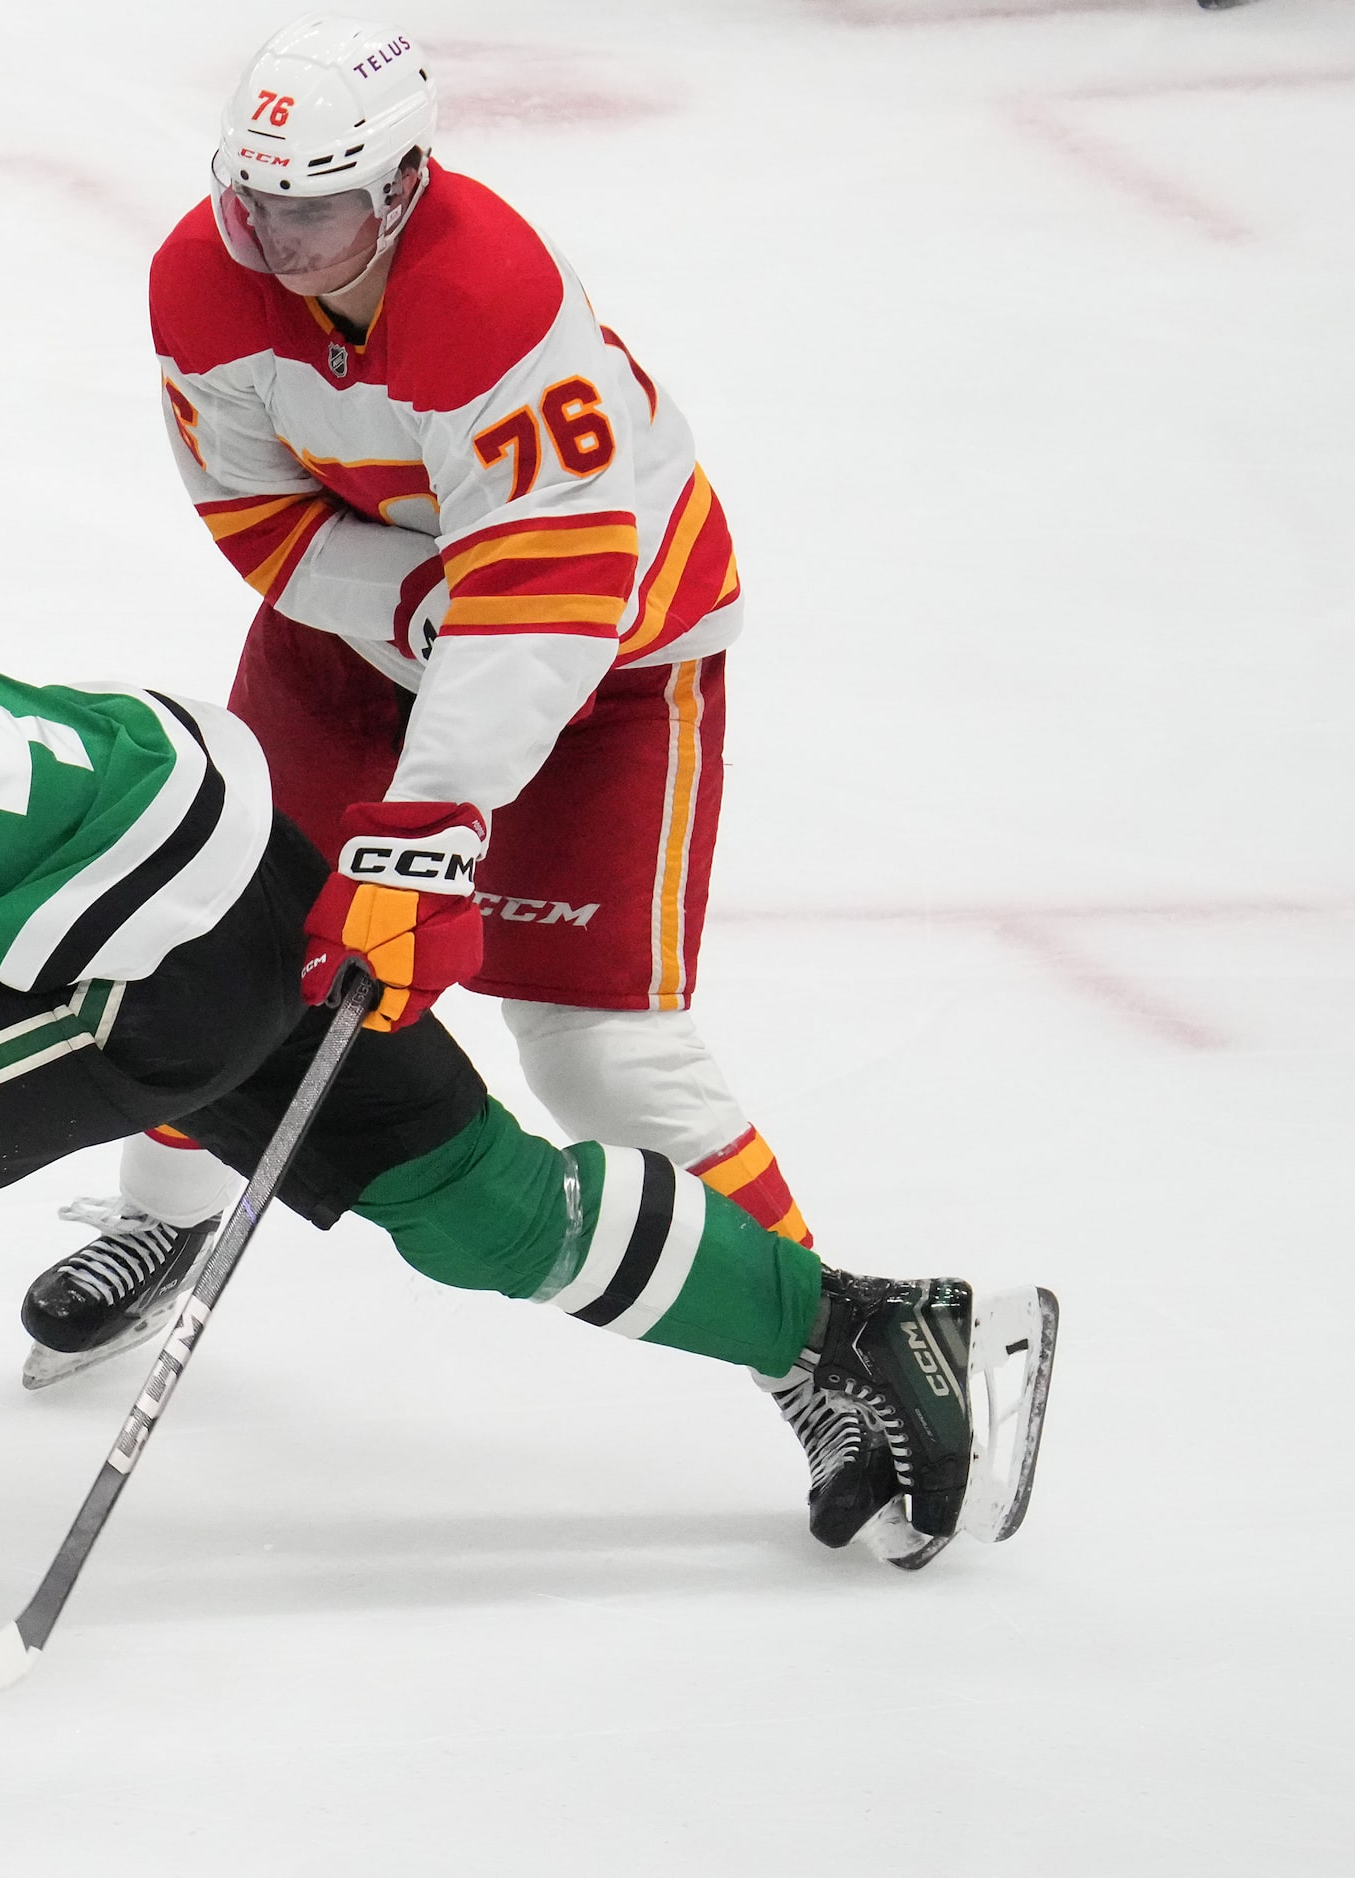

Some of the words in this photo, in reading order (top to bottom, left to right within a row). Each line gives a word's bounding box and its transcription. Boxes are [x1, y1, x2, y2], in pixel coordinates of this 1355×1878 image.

[353, 36, 411, 79] TELUS
[251, 90, 295, 127] 76
[240, 148, 291, 168] CCM
[473, 374, 616, 504] 76
[350, 847, 474, 882] CCM
[301, 953, 327, 979] CCM
[900, 1321, 950, 1397] CCM
[107, 1296, 211, 1475] CCM
